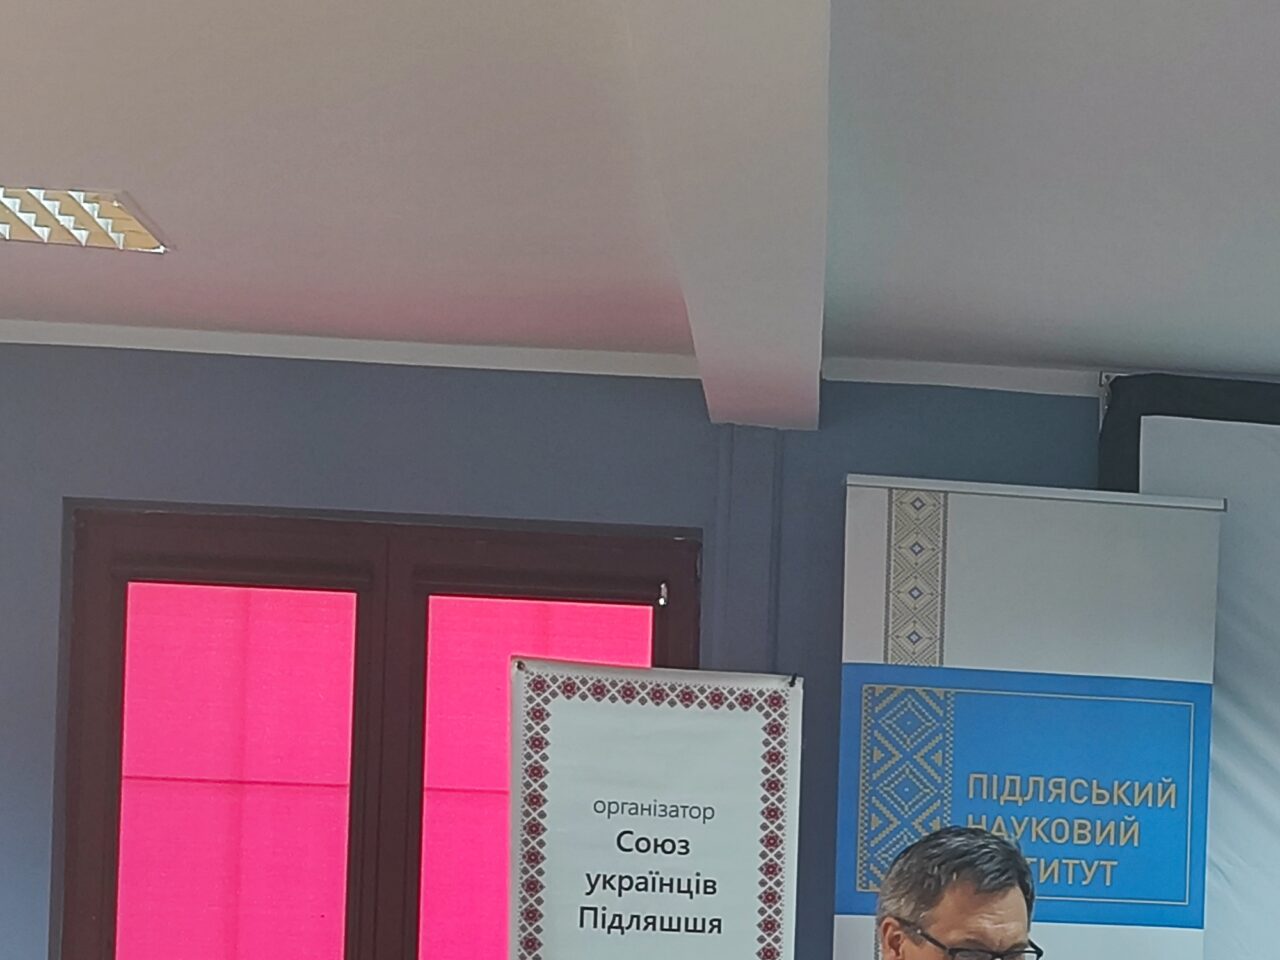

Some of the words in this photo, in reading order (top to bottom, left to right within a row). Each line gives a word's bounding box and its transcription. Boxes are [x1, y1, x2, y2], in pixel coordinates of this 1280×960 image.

[968, 773, 1178, 809] ПІДЛЯСЬКИЙ
[593, 799, 716, 823] організатор
[616, 830, 691, 856] Союз
[967, 814, 1141, 847] НАУКОВИЙ
[585, 870, 718, 900] українців
[578, 906, 723, 935] Підляшшя
